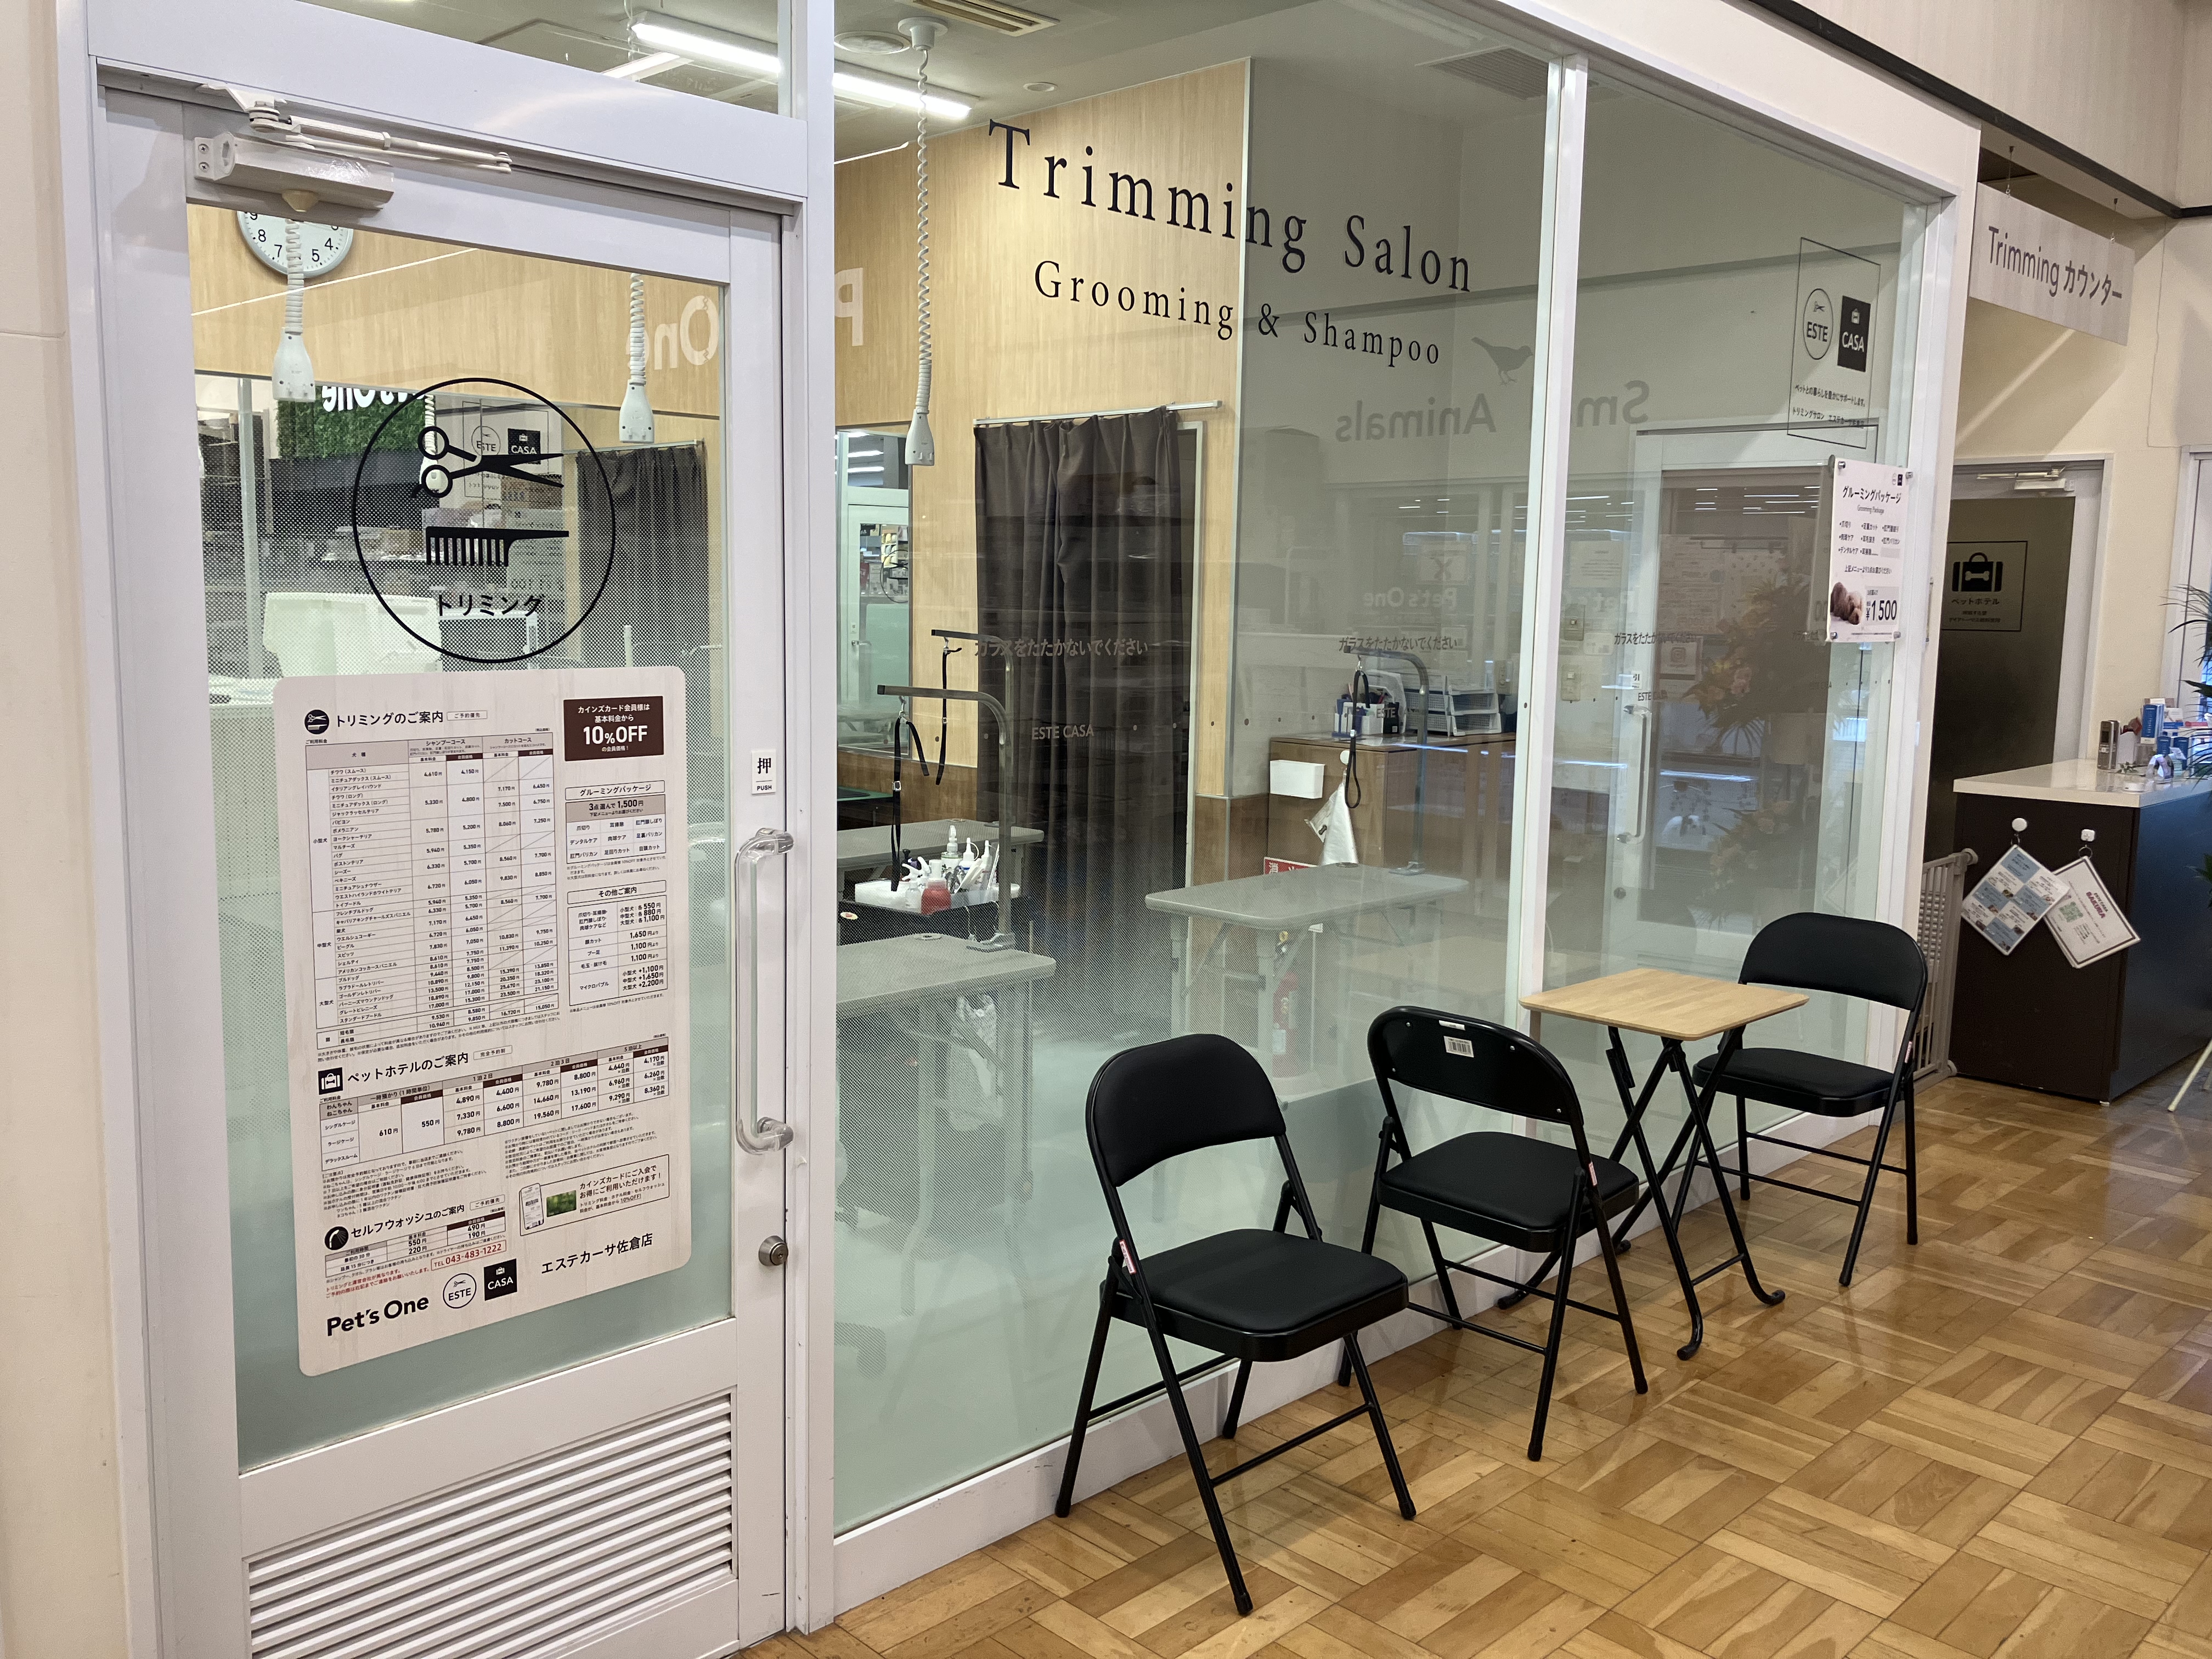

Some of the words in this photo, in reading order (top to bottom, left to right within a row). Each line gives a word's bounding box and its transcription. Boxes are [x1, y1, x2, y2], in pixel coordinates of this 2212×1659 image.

[988, 119, 1307, 273] Trimming
[1344, 215, 1470, 292] Salon
[258, 229, 266, 242] 8
[325, 238, 334, 250] 4
[274, 244, 282, 257] 7
[312, 249, 319, 262] 5
[1989, 226, 2059, 297] Trimming
[2064, 260, 2122, 306] カウンター
[1034, 260, 1234, 340] Grooming
[1259, 303, 1280, 338] &
[1304, 312, 1440, 368] Shampoo
[1807, 321, 1828, 342] ESTE
[1842, 331, 1865, 352] CASA
[511, 445, 537, 454] CASA
[1843, 486, 1901, 504] グルーミングパッケージ
[439, 594, 545, 617] トリミング
[975, 638, 1148, 657] ガラスをたたかないでください
[1339, 636, 1457, 651] ガラスをたたかないでください
[1638, 692, 1651, 701] ESTE
[578, 704, 650, 714] カインズカード会員様は
[1376, 708, 1396, 718] ESTE
[337, 711, 443, 727] トリミングのご案内
[595, 714, 634, 723] 基本料金から
[583, 725, 648, 744] 10%OFF
[1031, 726, 1060, 741] ESTE
[1063, 725, 1094, 738] CASA
[757, 758, 771, 774] 押
[580, 784, 651, 796] グルーミングパッケージ
[617, 799, 644, 808] 1,500円
[599, 887, 637, 898] その他ご案内
[348, 1052, 469, 1082] ペットホテルのご案内
[574, 1071, 596, 1080] 8,800円
[537, 1079, 558, 1088] 9,780円
[496, 1087, 519, 1096] 4,400円
[571, 1087, 596, 1096] 13,190円
[327, 1101, 352, 1110] わんちゃん
[456, 1095, 479, 1104] 4,890円
[497, 1103, 520, 1112] 6,600円
[572, 1102, 596, 1111] 17,600円
[457, 1111, 481, 1120] 7,330円
[325, 1120, 356, 1130] シングルケージ
[422, 1119, 439, 1127] 550円
[498, 1119, 520, 1127] 8,800円
[379, 1127, 398, 1136] 610円
[458, 1127, 481, 1136] 9,780円
[580, 1165, 657, 1190] カインズカードにご入会で
[580, 1172, 661, 1199] お得にご利用いただけます！
[351, 1204, 465, 1239] セルフウォッシュのご案内
[469, 1231, 485, 1239] 190円
[409, 1238, 426, 1246] 550円
[409, 1246, 427, 1255] 220円
[445, 1244, 501, 1264] 043-483-1222
[541, 1233, 653, 1274] エステカーサ佐倉店
[488, 1276, 514, 1290] CASA
[448, 1287, 472, 1301] ESTE
[327, 1309, 380, 1336] Pet's
[384, 1297, 429, 1319] One
